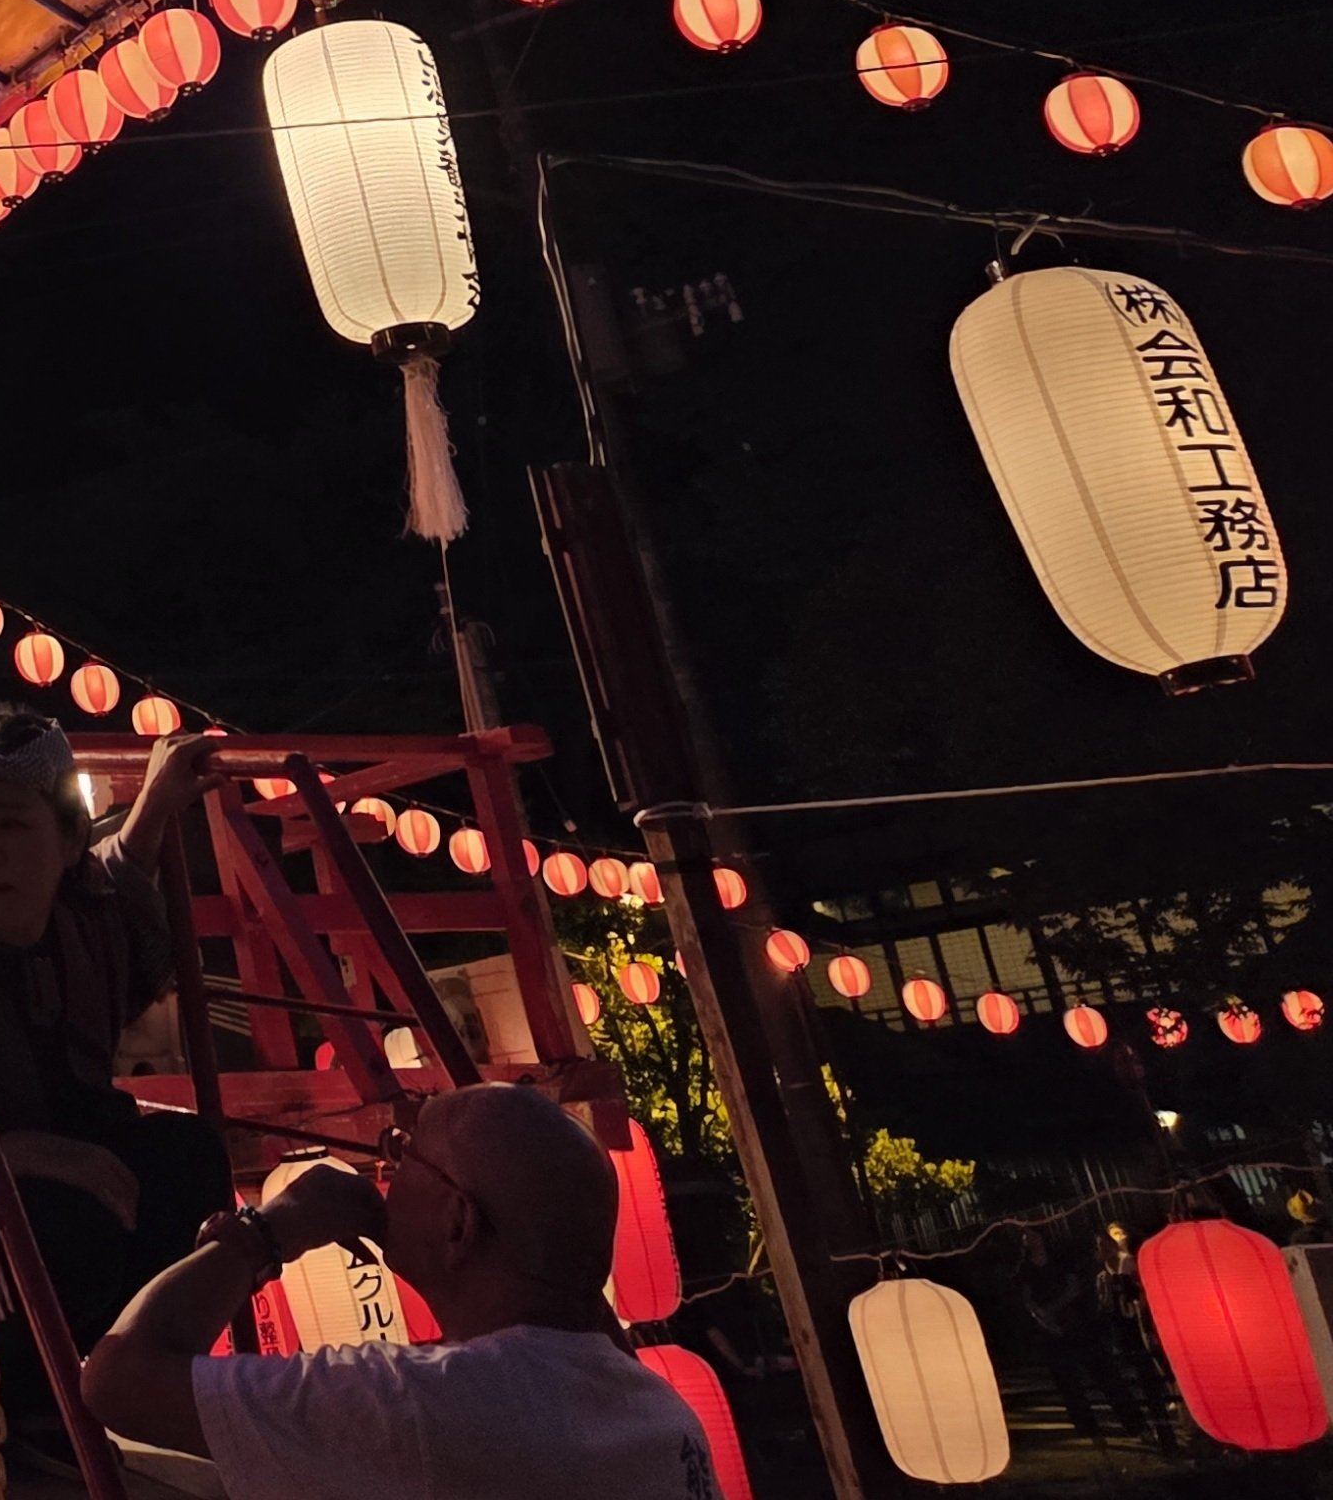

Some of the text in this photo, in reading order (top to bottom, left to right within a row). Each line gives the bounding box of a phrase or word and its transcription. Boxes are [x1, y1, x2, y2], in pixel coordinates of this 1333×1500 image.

[1103, 280, 1279, 610] (株)会和工務店
